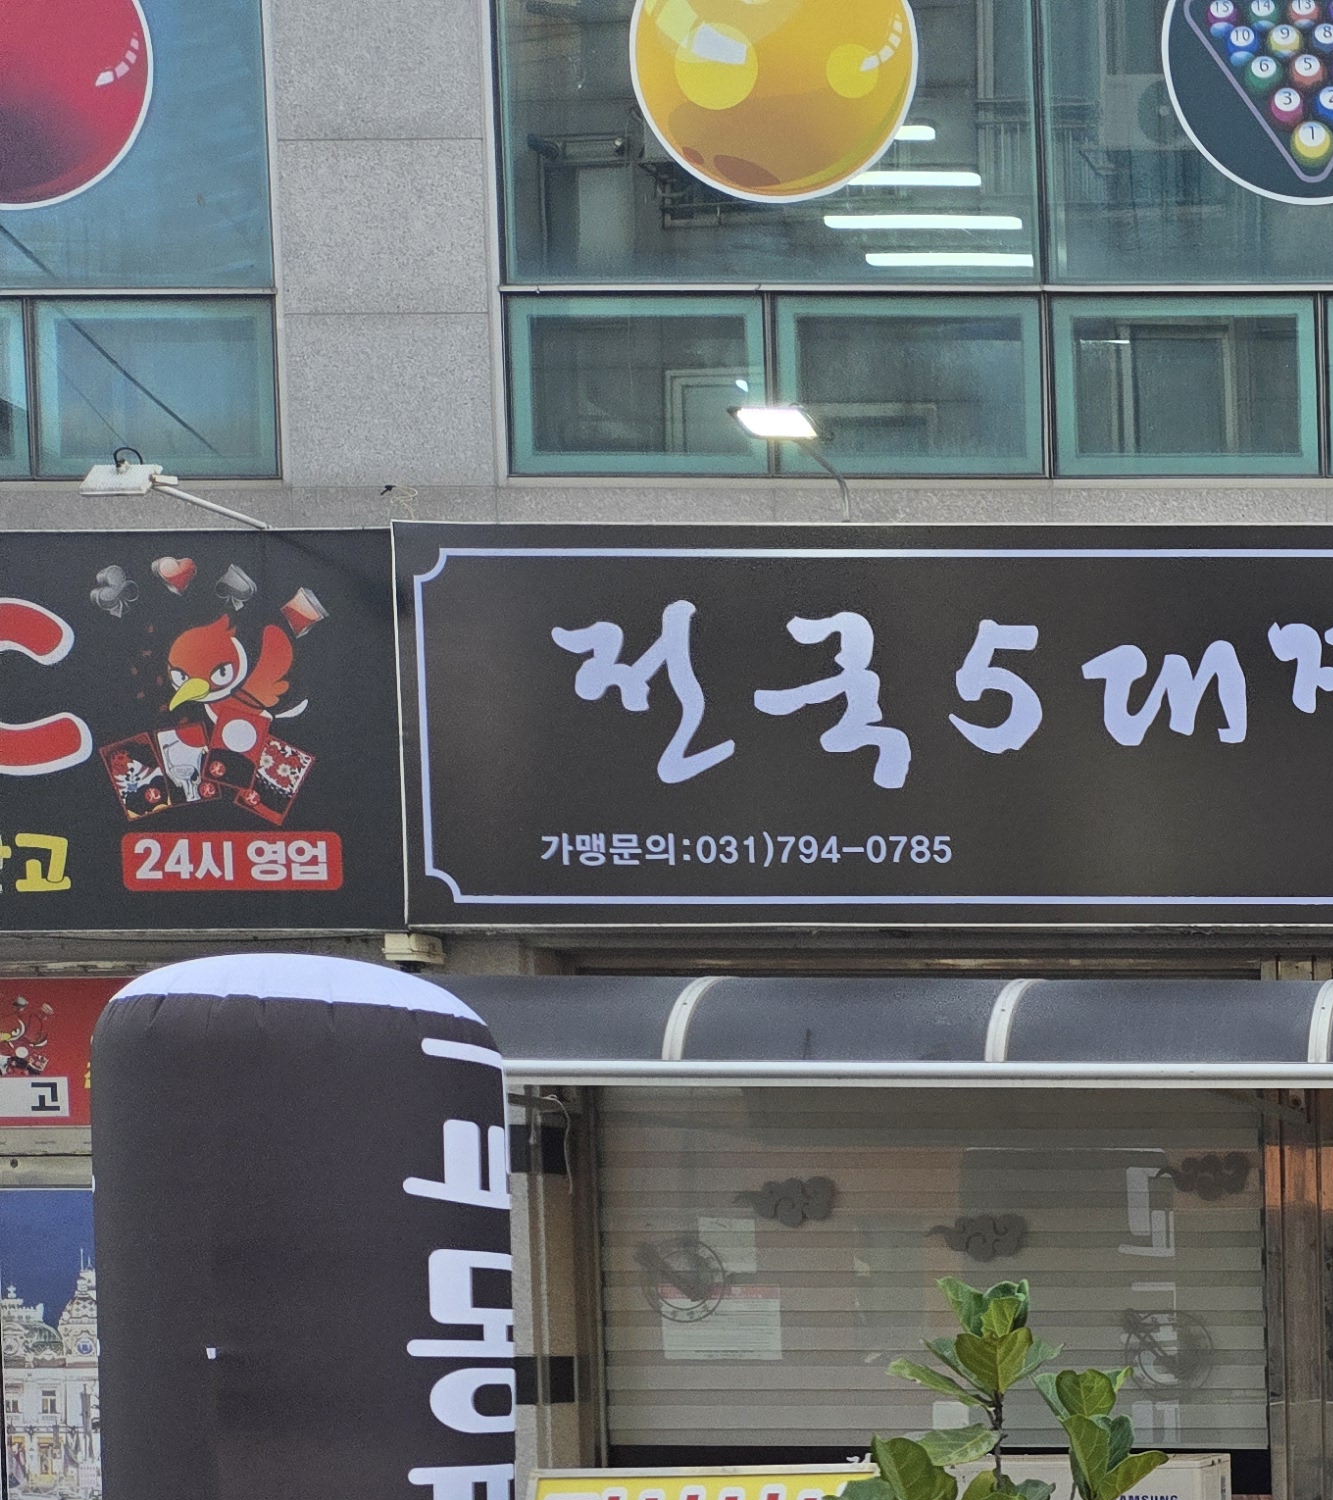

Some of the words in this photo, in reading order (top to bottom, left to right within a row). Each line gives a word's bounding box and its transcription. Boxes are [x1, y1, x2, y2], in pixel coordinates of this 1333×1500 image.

[1234, 29, 1250, 41] 10
[1280, 27, 1290, 39] 9
[1323, 26, 1333, 39] 8
[1259, 58, 1269, 72] 6
[1303, 57, 1312, 71] 5
[1282, 91, 1292, 105] 3
[1309, 126, 1316, 140] 1
[0, 833, 71, 892] 고
[135, 839, 234, 881] 24시
[247, 840, 329, 881] 영업
